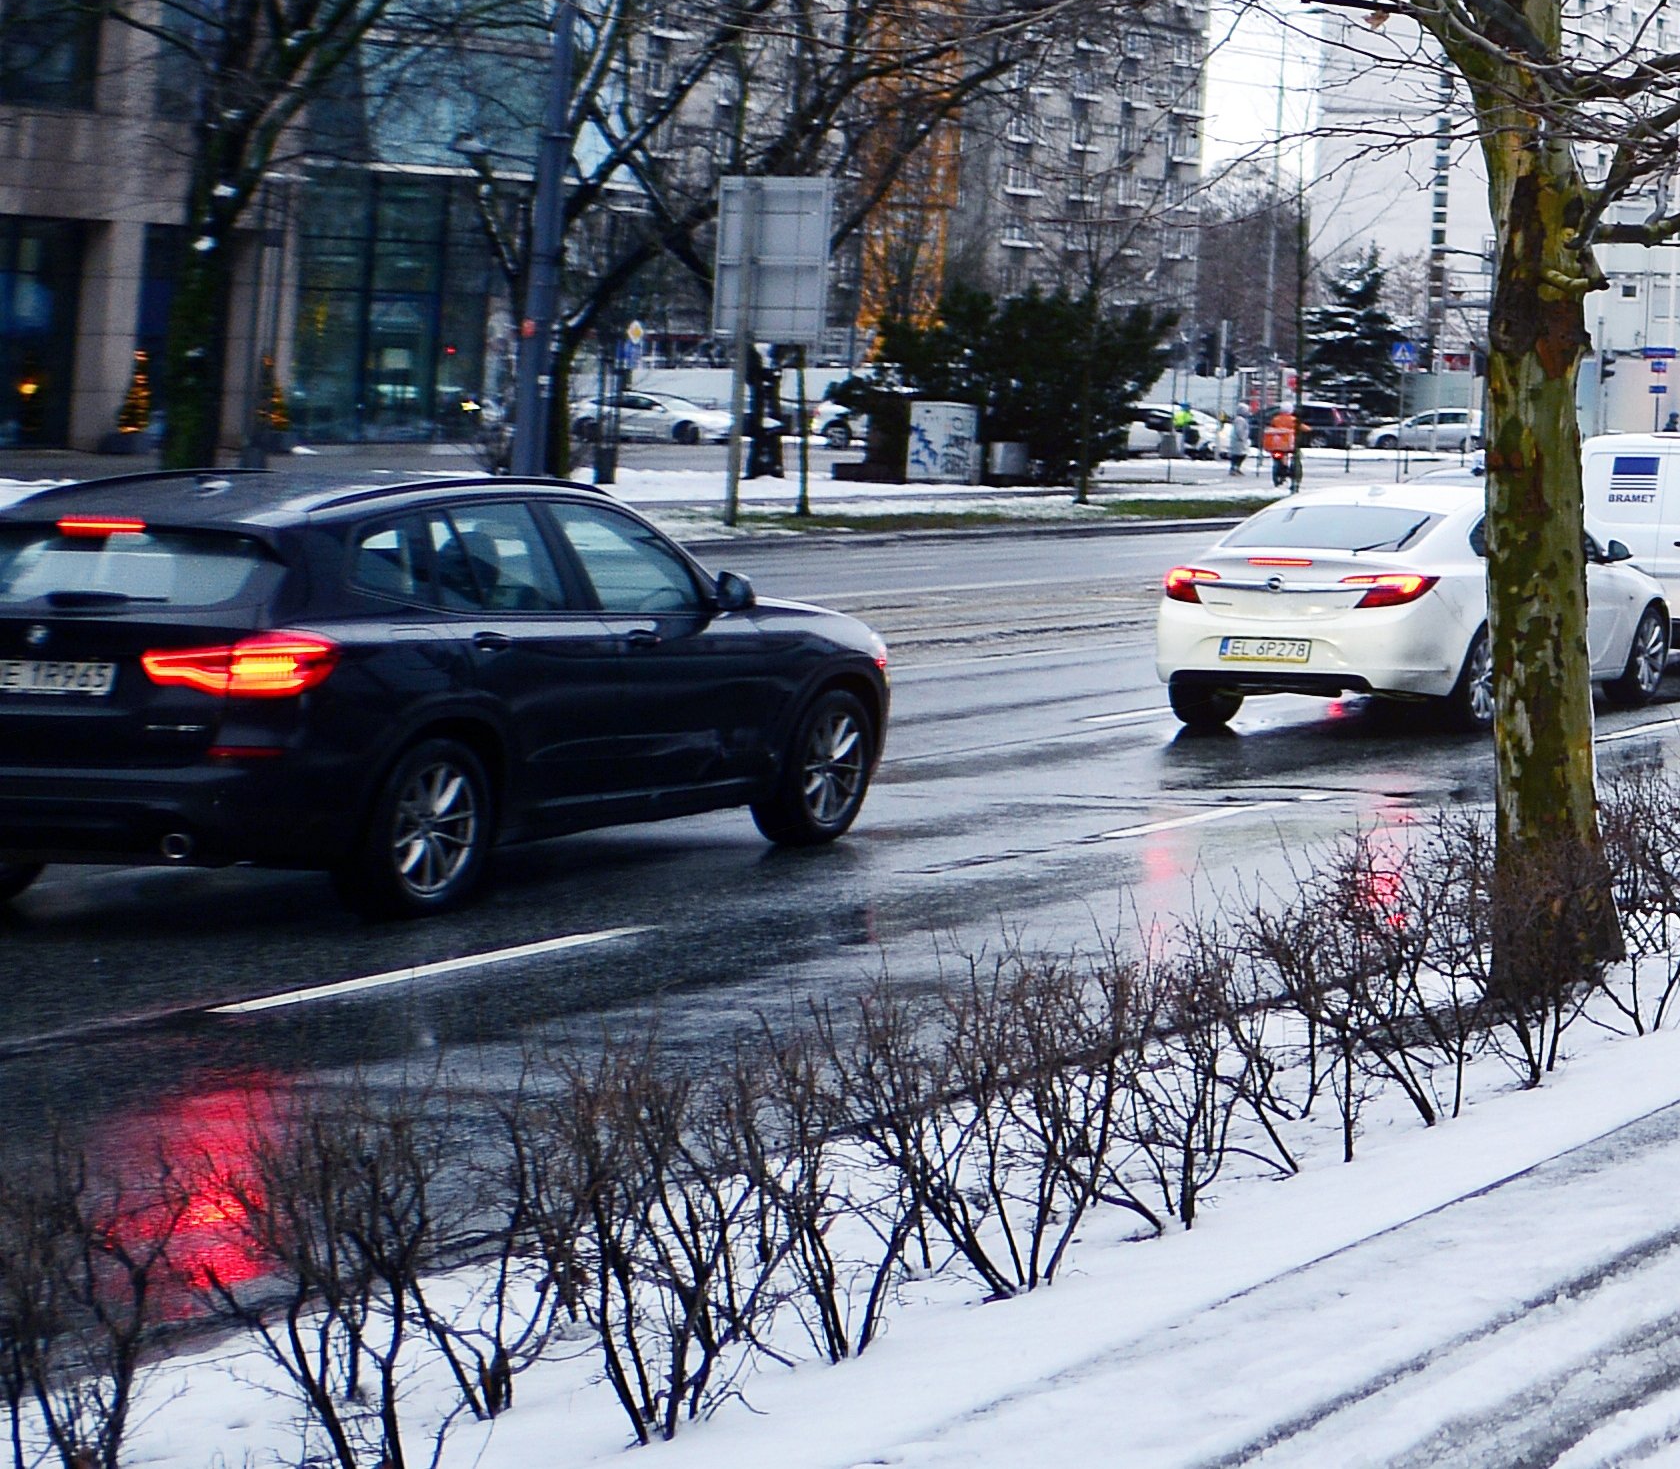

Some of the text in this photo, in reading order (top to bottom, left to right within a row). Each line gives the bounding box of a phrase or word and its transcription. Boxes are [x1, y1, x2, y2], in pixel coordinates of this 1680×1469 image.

[1608, 493, 1656, 503] BRAMET
[1231, 640, 1306, 657] EL 6P278
